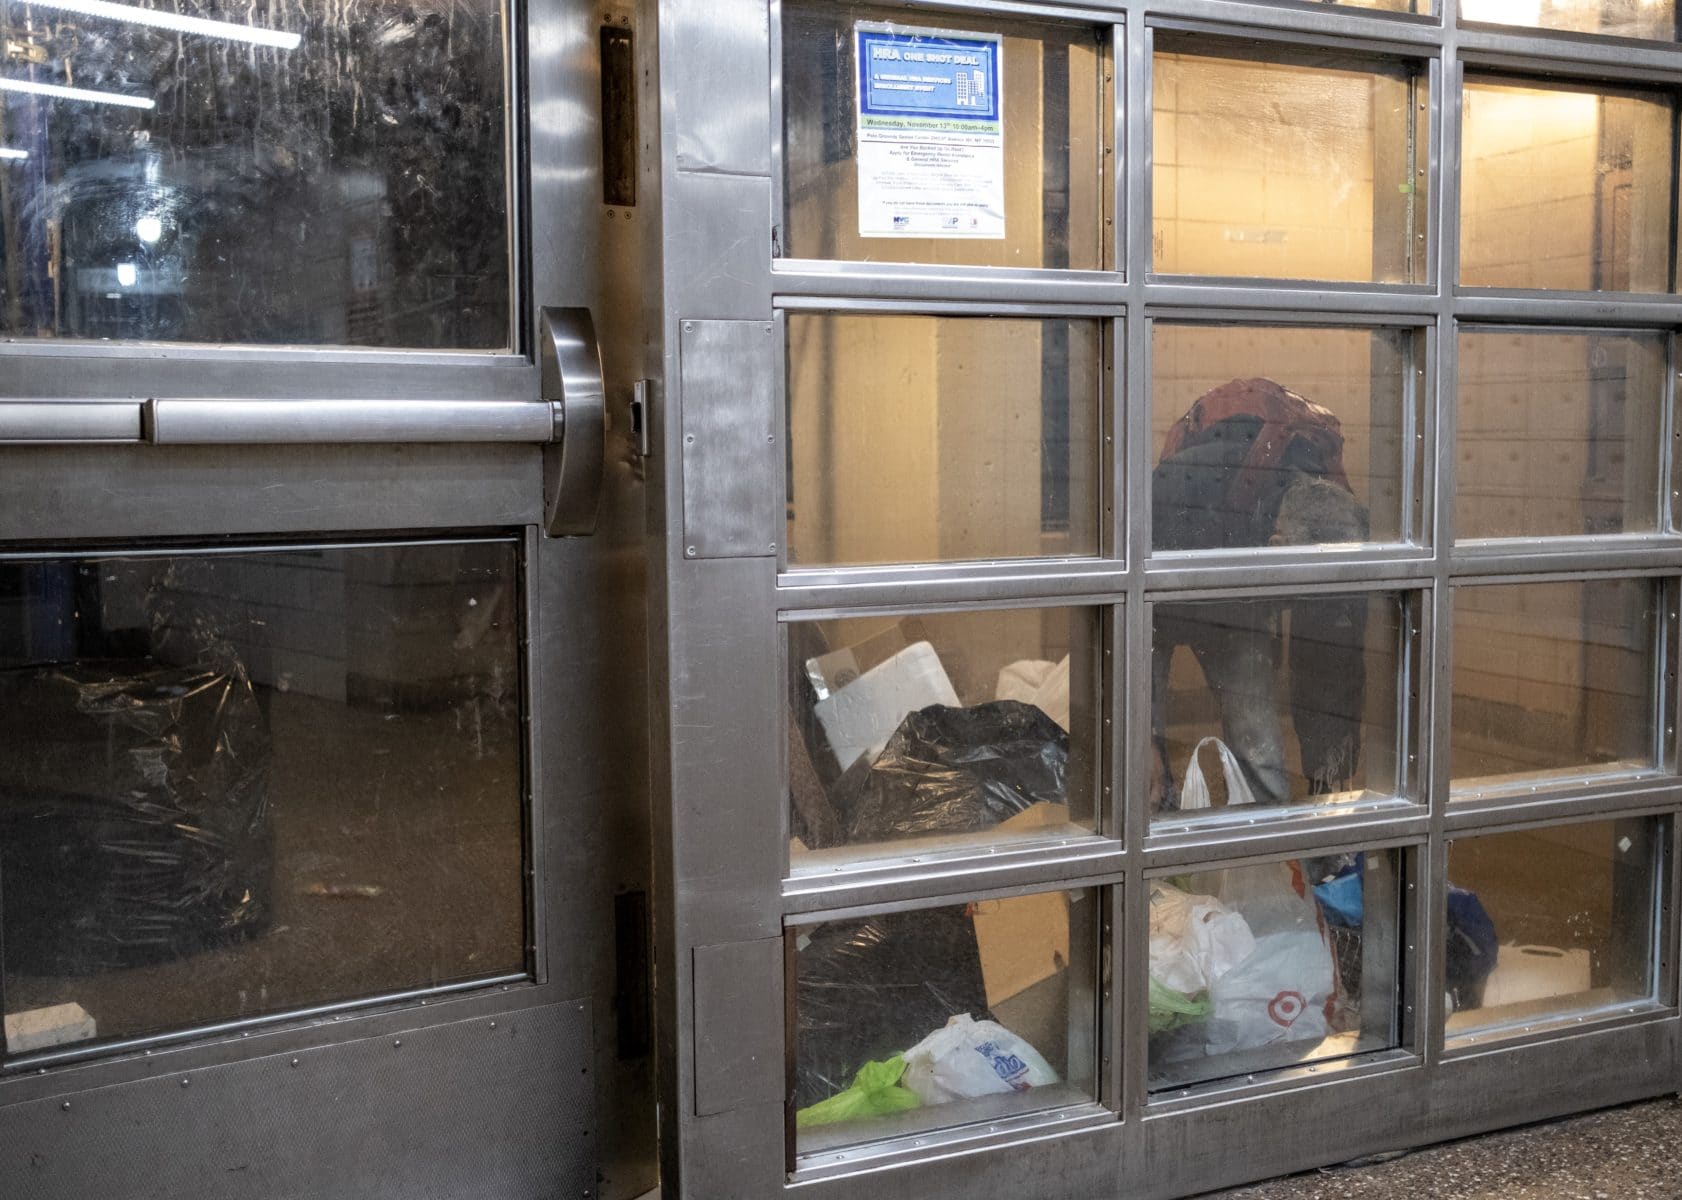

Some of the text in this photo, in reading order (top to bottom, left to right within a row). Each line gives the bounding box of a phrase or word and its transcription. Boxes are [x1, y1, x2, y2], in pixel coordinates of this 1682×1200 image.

[873, 47, 980, 66] HRA ONE SHOT DEAL
[907, 121, 938, 129] November
